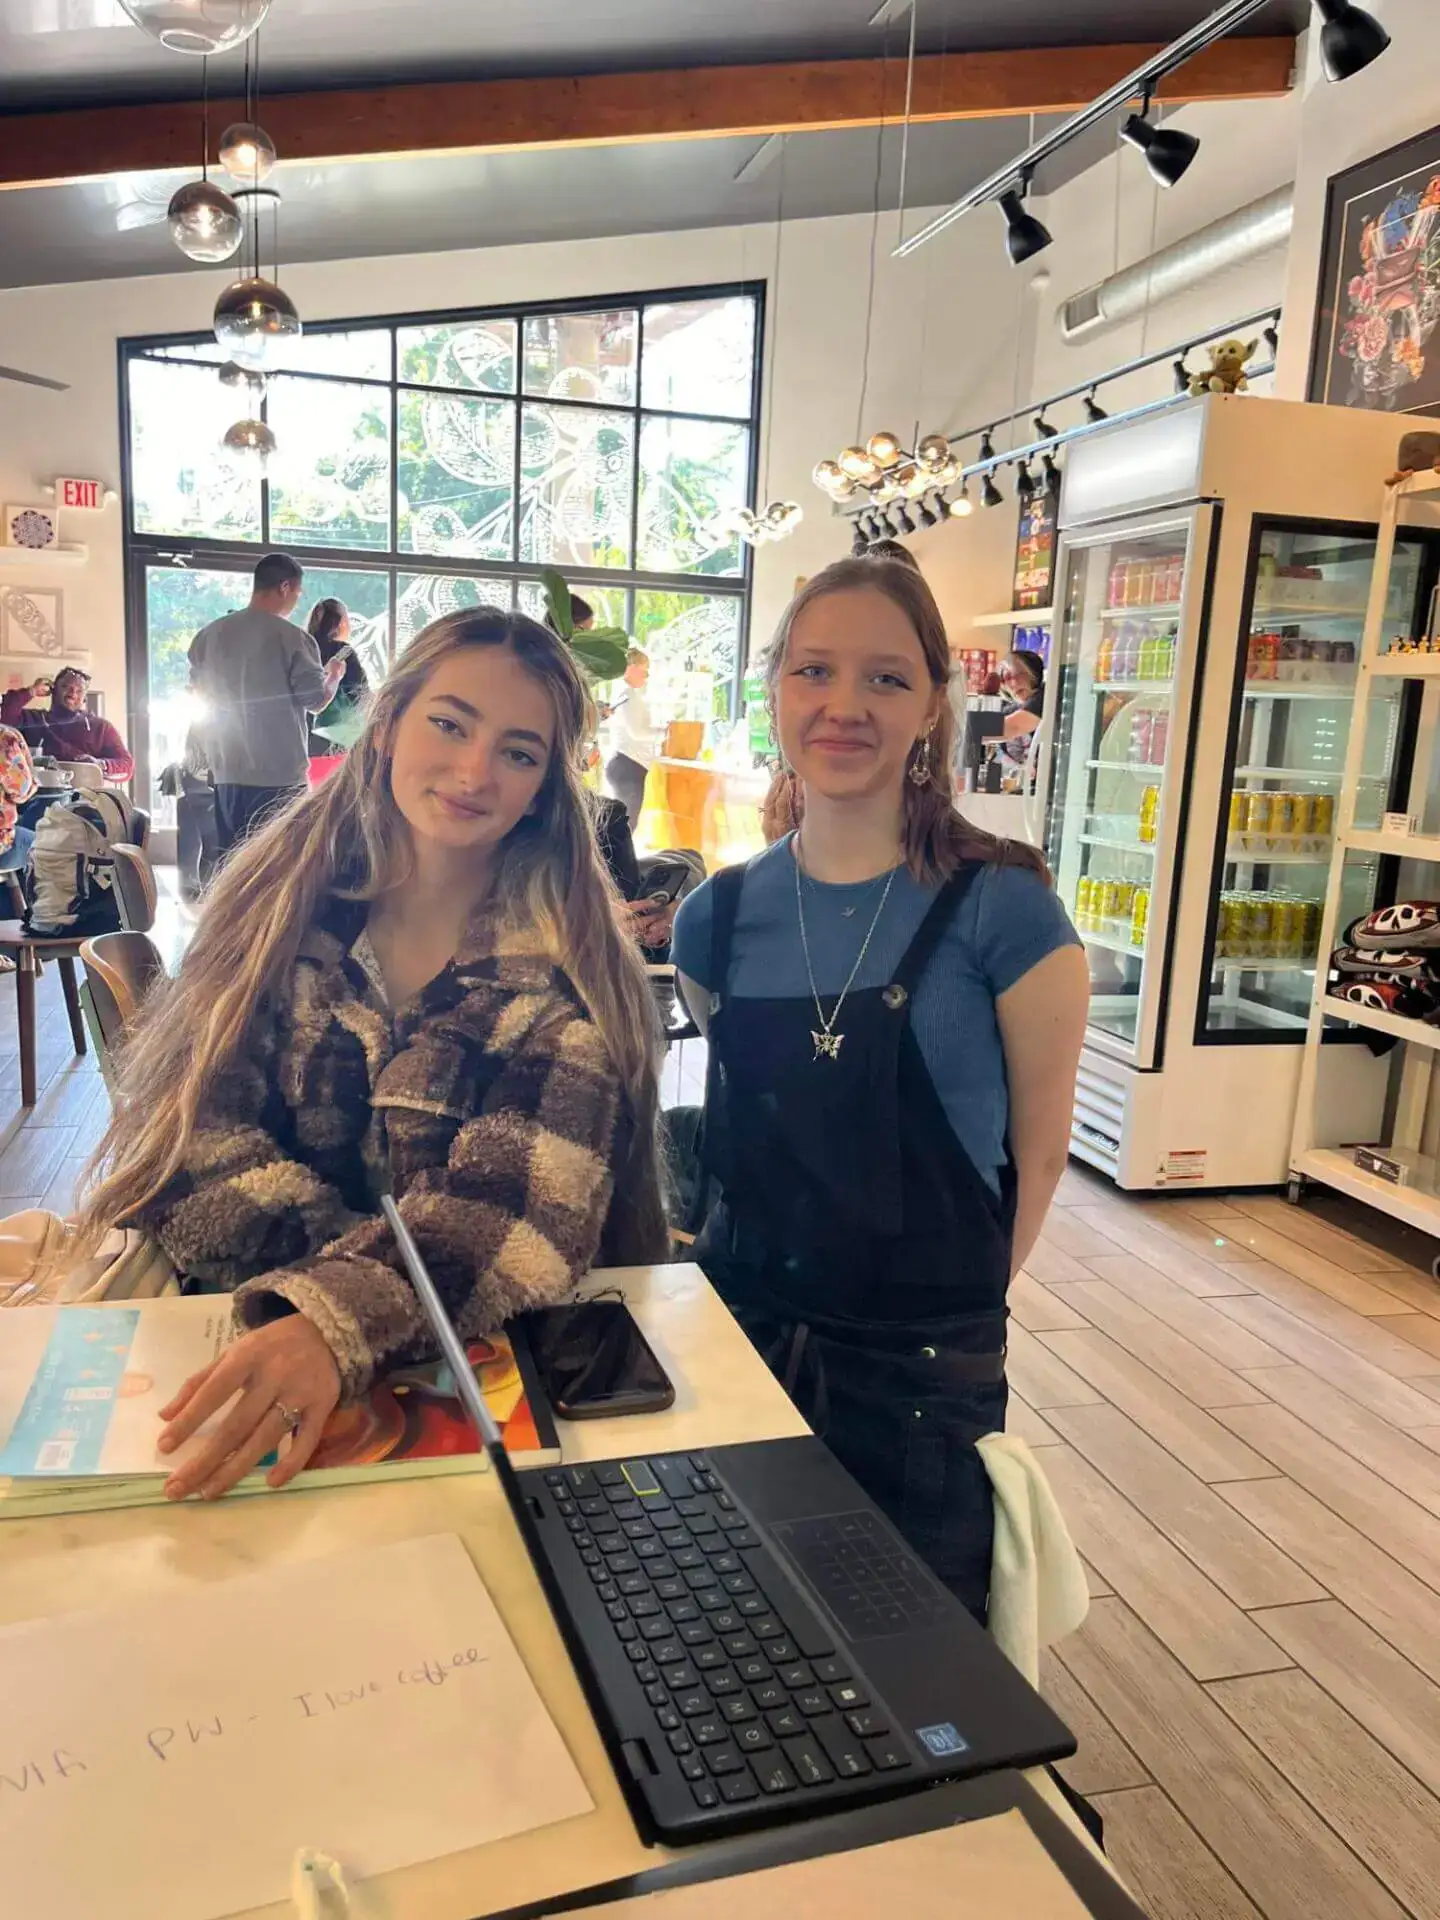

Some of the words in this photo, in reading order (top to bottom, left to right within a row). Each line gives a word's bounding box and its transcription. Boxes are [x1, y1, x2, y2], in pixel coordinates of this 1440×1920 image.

[64, 480, 98, 508] EXIT
[147, 1711, 223, 1760] PW
[397, 1648, 490, 1686] coffee
